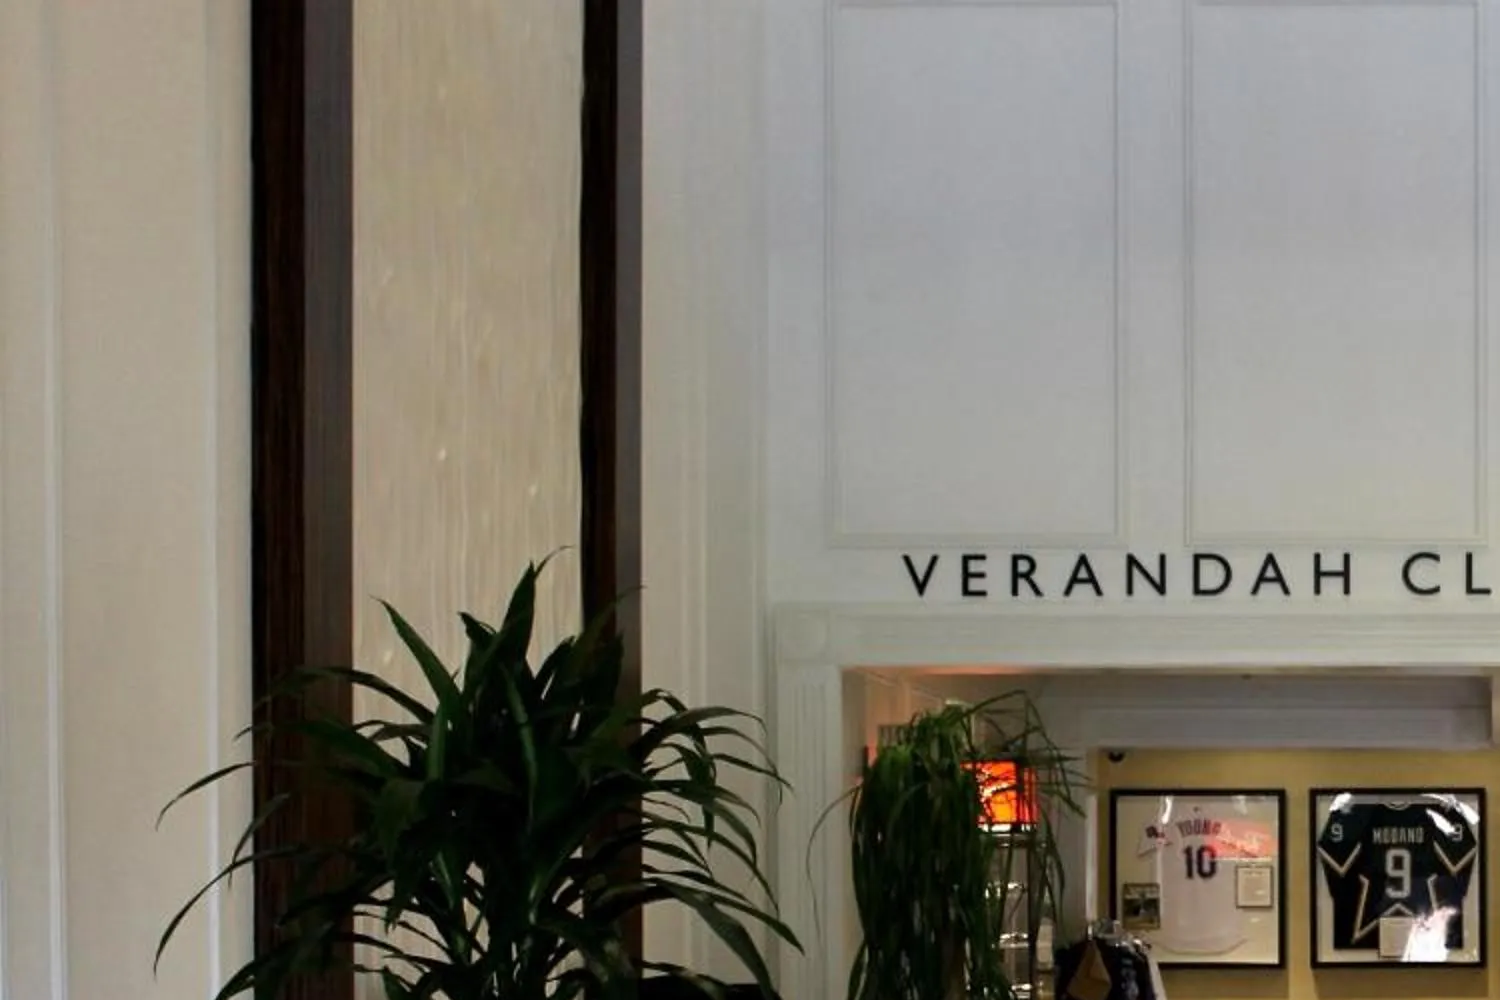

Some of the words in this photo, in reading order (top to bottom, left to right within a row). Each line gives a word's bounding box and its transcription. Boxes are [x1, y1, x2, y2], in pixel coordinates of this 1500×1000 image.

[902, 552, 1352, 598] VERANDAH
[1331, 823, 1344, 842] 9
[1183, 843, 1217, 880] 10
[1385, 848, 1412, 899] 9
